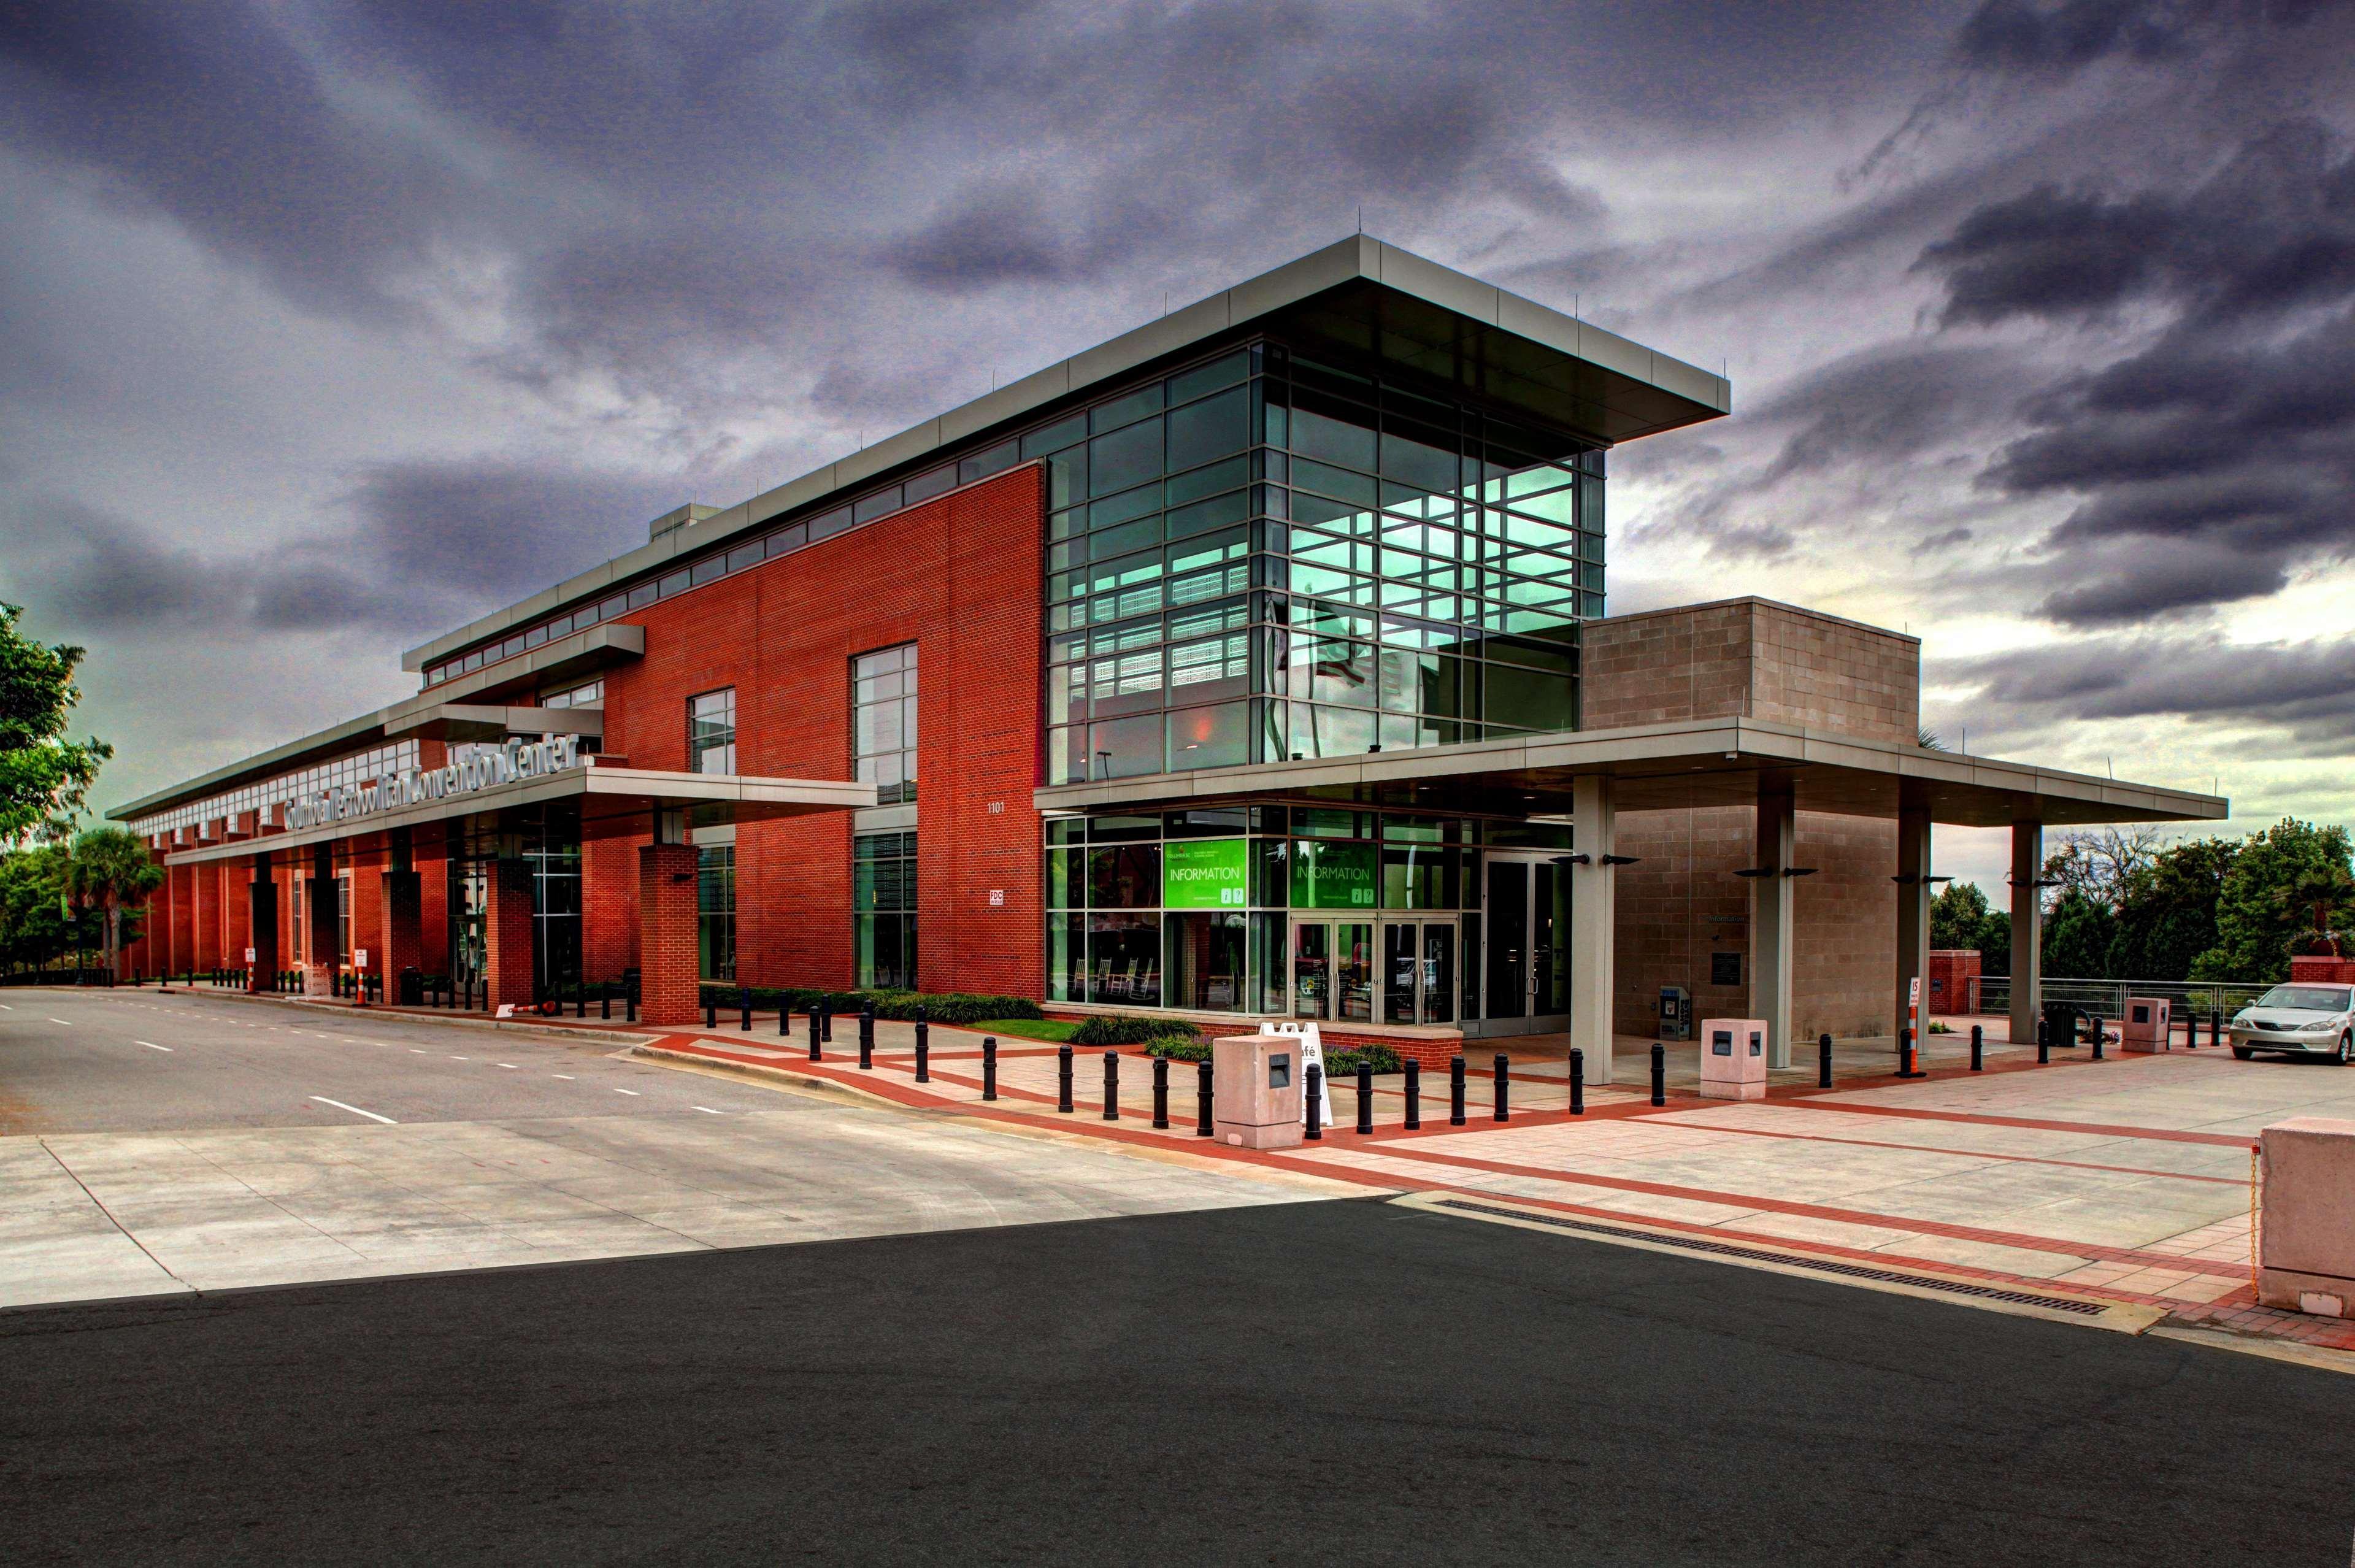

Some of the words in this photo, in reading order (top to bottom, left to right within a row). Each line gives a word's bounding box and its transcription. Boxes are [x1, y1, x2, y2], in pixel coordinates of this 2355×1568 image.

[284, 792, 330, 830] Columbia
[329, 774, 410, 820] Metropolitan
[412, 747, 504, 802] Convention
[506, 732, 578, 782] Center
[987, 801, 1004, 813] 1101
[1170, 867, 1240, 881] INFORMATION
[1297, 866, 1370, 880] INFORMATION
[1912, 981, 1918, 991] 15
